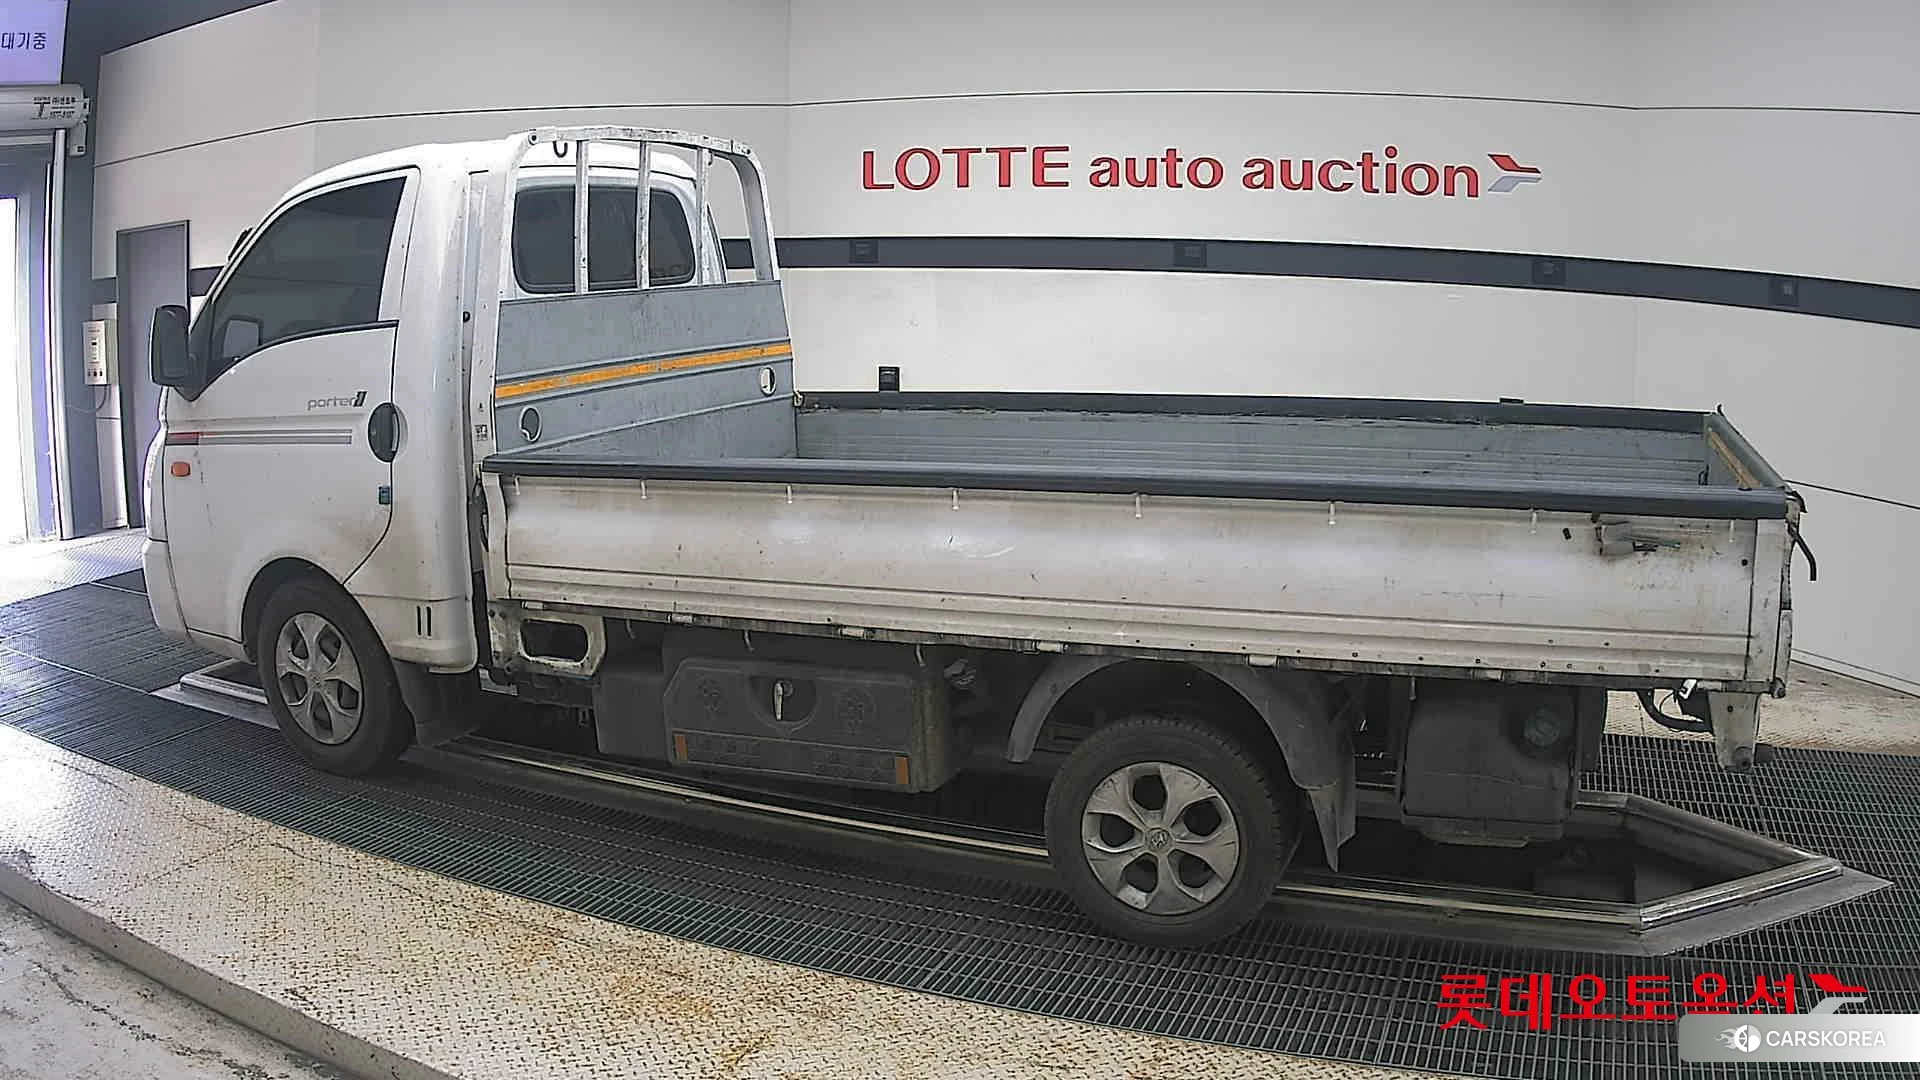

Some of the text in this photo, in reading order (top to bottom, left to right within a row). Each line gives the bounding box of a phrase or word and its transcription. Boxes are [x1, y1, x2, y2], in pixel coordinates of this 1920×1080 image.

[1, 32, 47, 50] 대기중
[863, 146, 1480, 198] LOTTE auto auction
